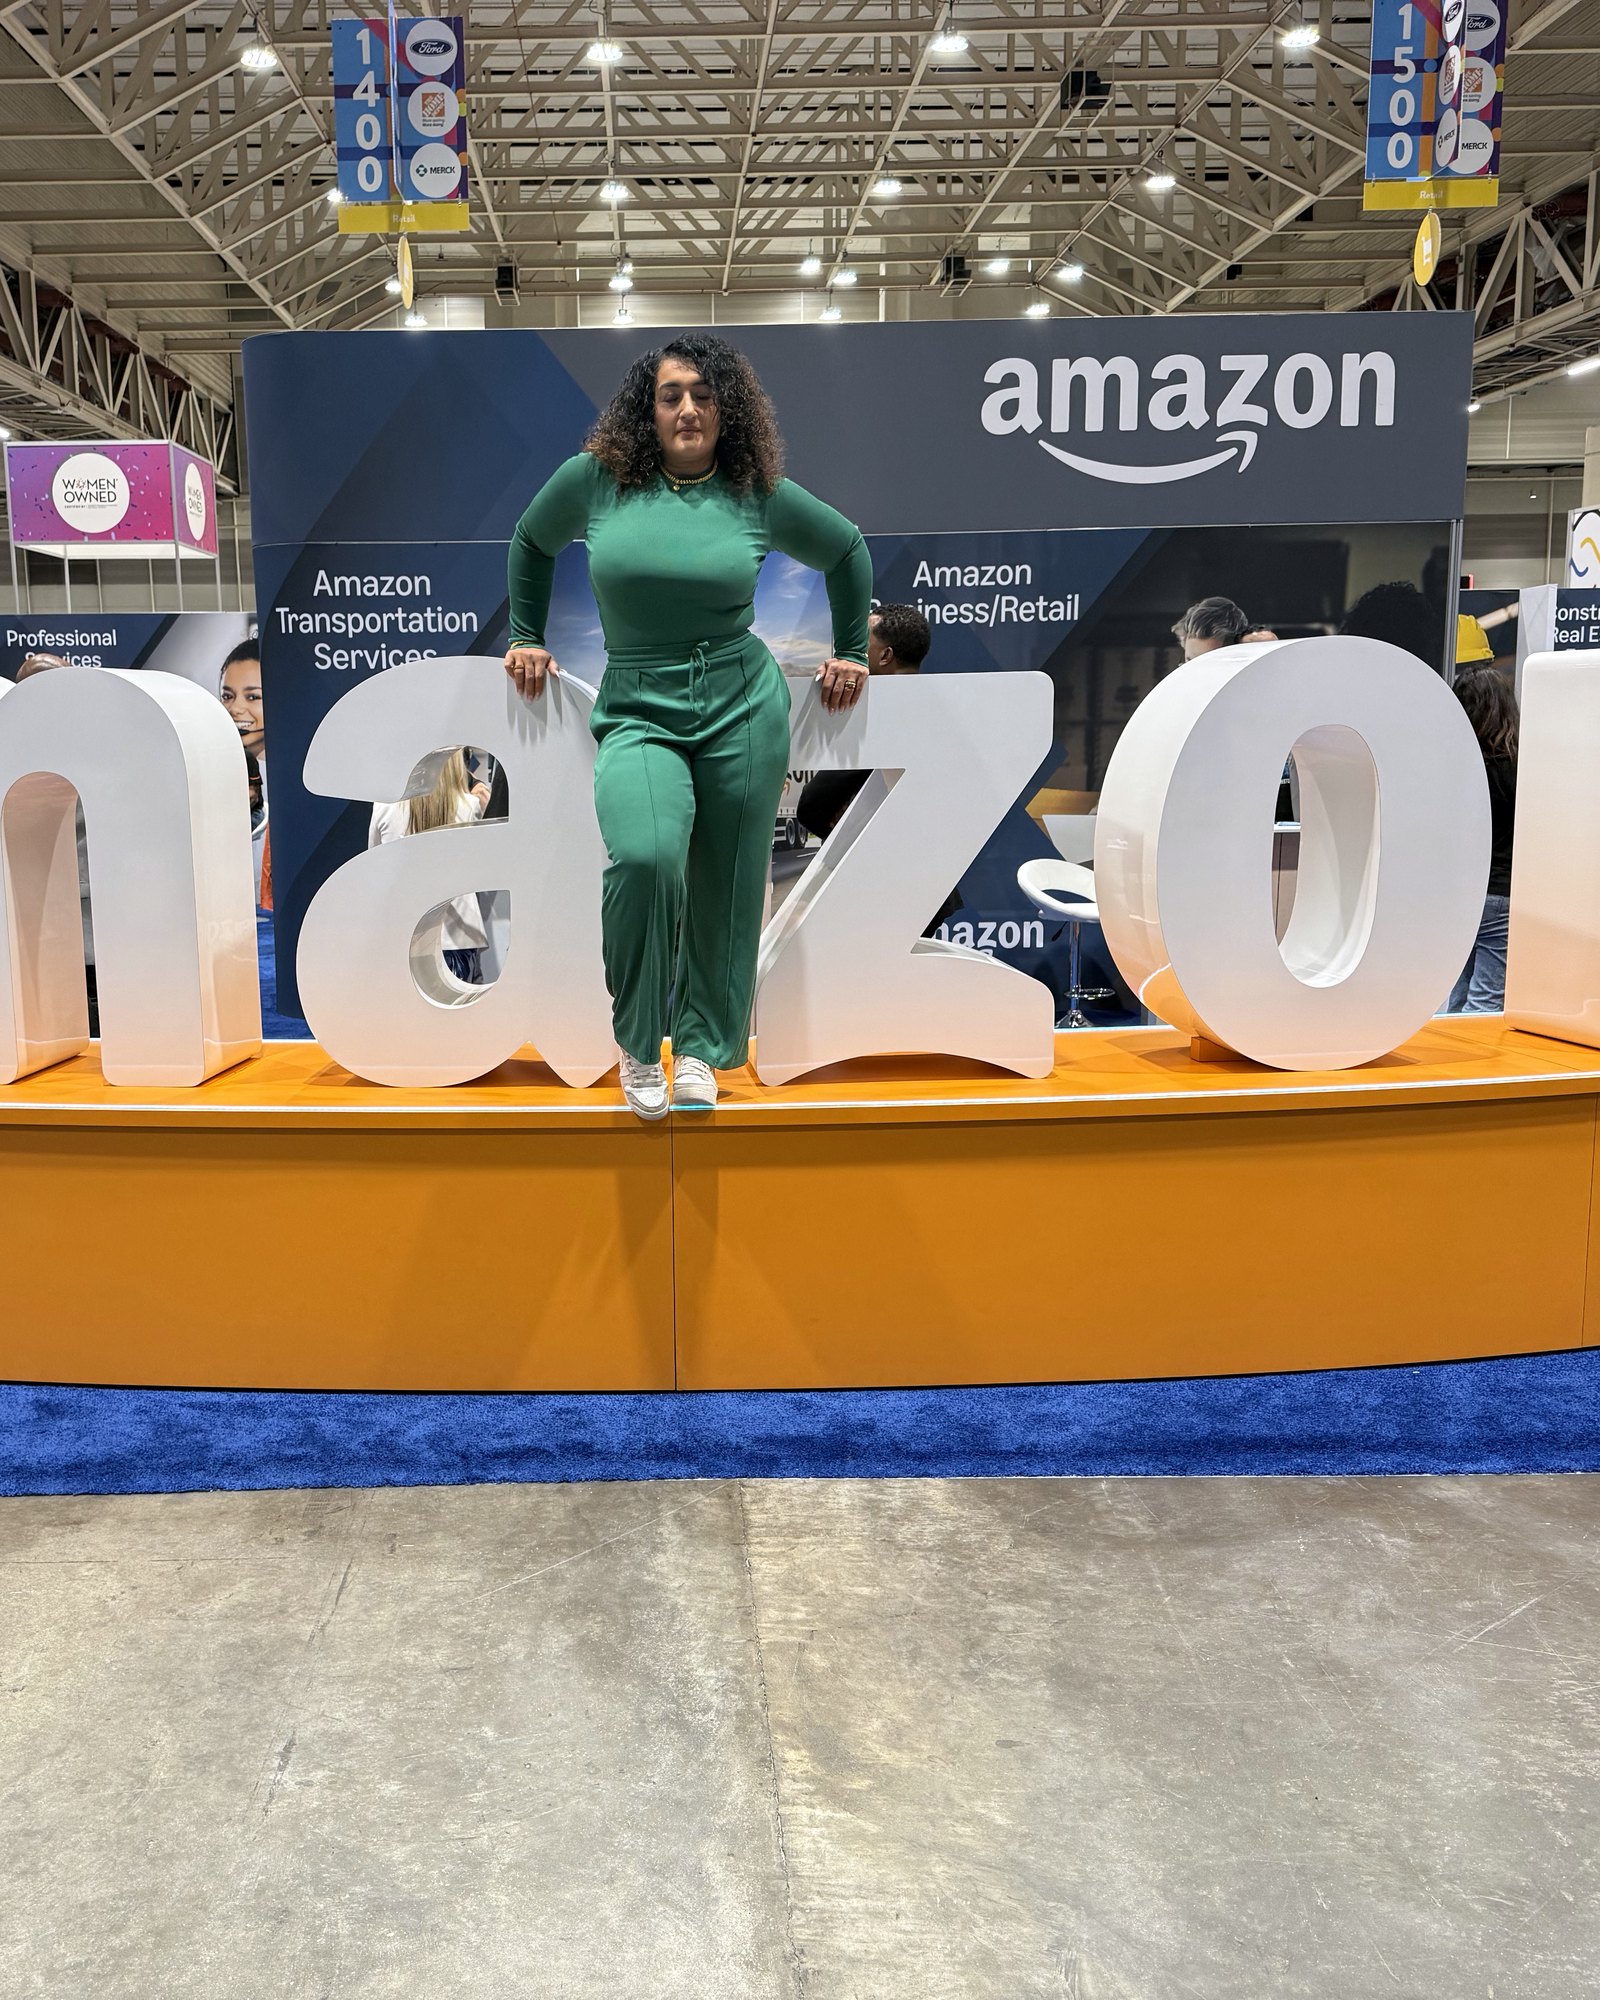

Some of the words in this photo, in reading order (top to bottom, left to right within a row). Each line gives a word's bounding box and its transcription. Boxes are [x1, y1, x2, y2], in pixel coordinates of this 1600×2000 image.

[418, 41, 445, 54] Ford
[1461, 142, 1488, 150] MERCK
[430, 166, 456, 175] MERCK
[1420, 190, 1443, 199] Retail
[392, 214, 416, 223] Retail
[980, 351, 1396, 435] amazon
[64, 491, 117, 503] OWNED
[911, 560, 1032, 588] Amazon
[313, 569, 431, 597] Amazon
[275, 606, 478, 638] Transportation
[6, 628, 117, 647] Professional
